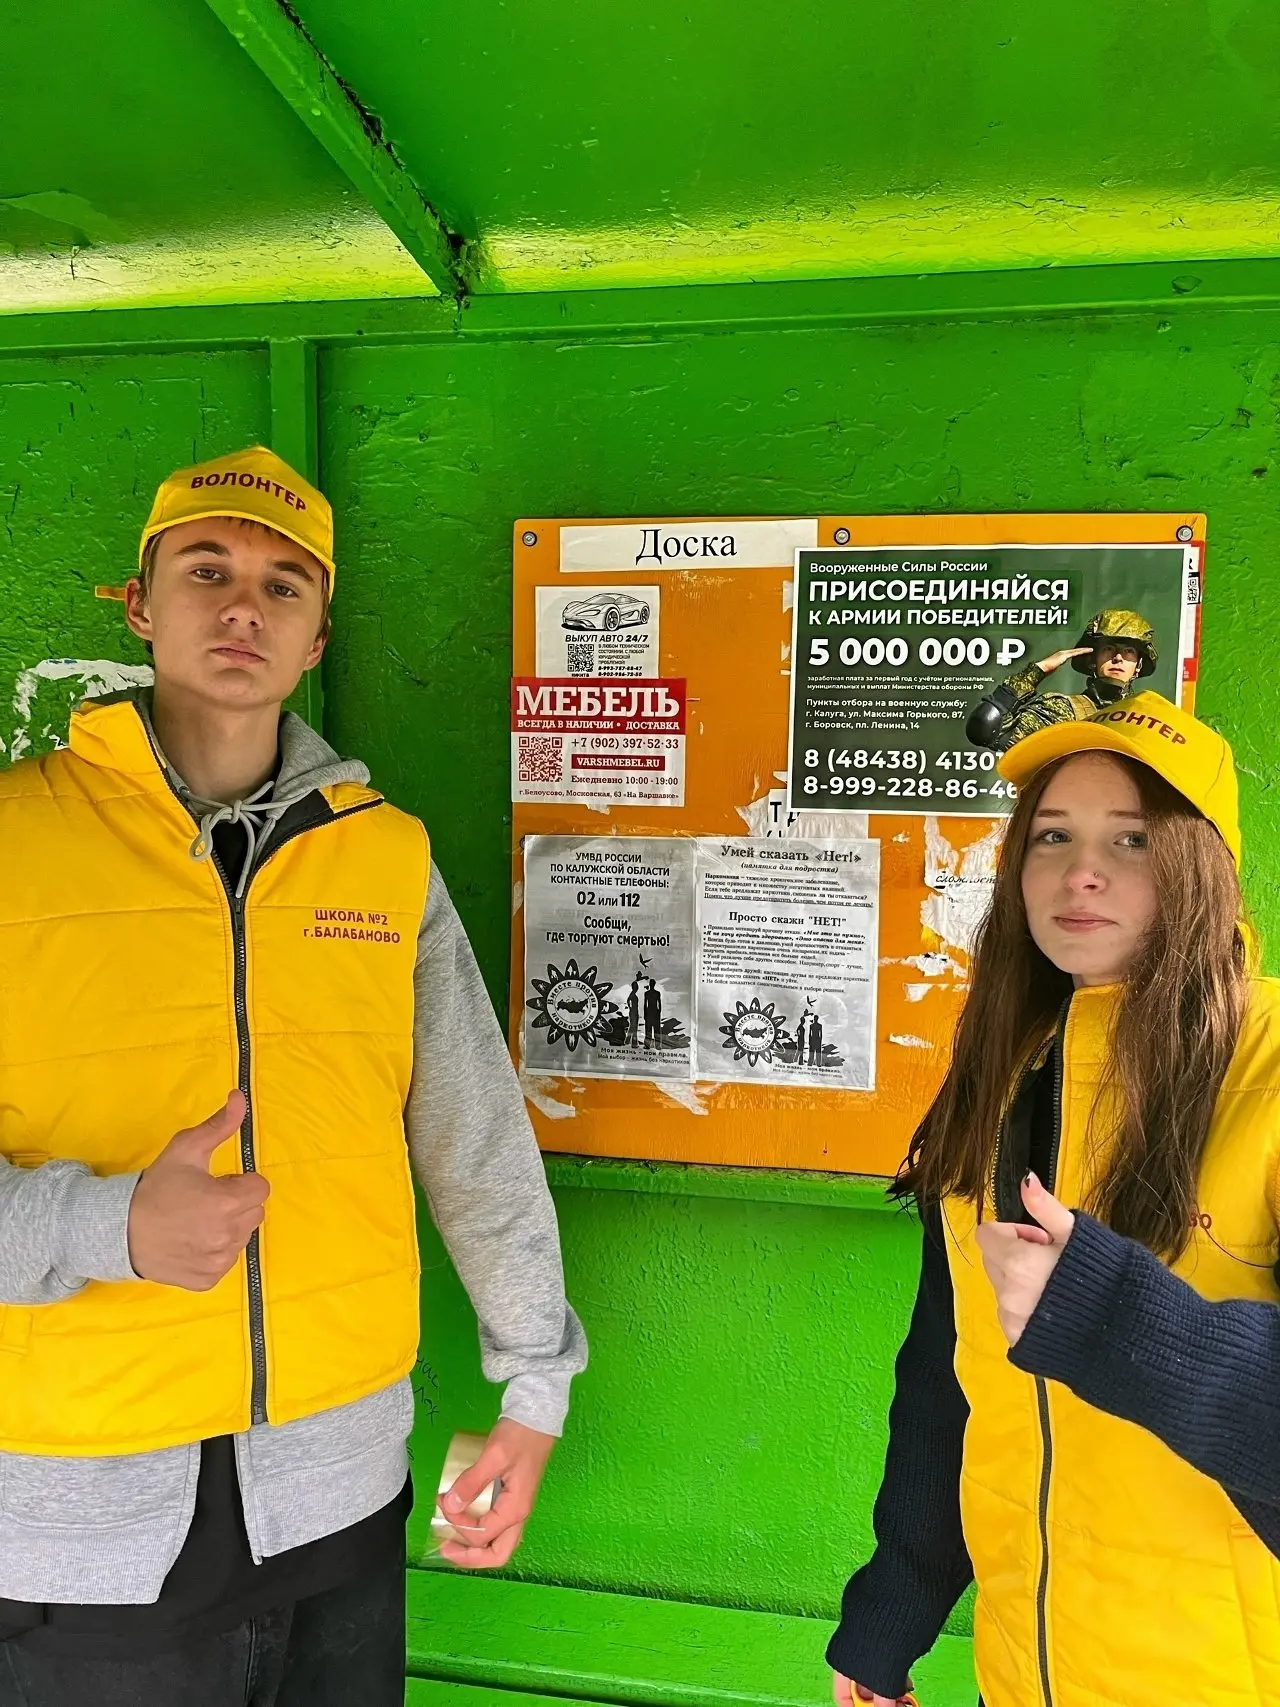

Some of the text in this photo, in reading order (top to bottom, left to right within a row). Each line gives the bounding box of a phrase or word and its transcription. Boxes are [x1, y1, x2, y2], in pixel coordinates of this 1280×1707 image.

[190, 472, 307, 511] ВОЛОНТЕР
[635, 528, 737, 566] Доска
[810, 561, 988, 575] Вооруженные Силы России
[809, 574, 1069, 604] ПРИСОЕДИНЯЙСЯ
[808, 606, 1068, 627] К АРМИИ ПОБЕДИТЕЛЕЙ!
[565, 634, 649, 643] ВЫКУП АВТО 24/7
[808, 638, 829, 666] 5
[839, 637, 908, 666] 000
[918, 637, 990, 666] 000
[516, 685, 680, 718] МЕБЕЛЬ
[806, 699, 840, 707] Пункты
[930, 700, 968, 708] службу:
[814, 710, 847, 718] Калуга,
[906, 711, 950, 720] Горького,
[951, 711, 965, 719] 87,
[517, 719, 556, 730] ВСЕГДА
[566, 720, 614, 729] НАЛИЧИИ
[626, 721, 680, 730] ДОСТАВКА
[814, 721, 854, 730] Боровск,
[870, 722, 908, 730] Ленина,
[571, 738, 587, 748] +7
[590, 737, 620, 750] (902)
[576, 757, 660, 768] VARSHMEBEL.RU
[804, 749, 819, 768] 8
[827, 748, 927, 774] (48438)
[571, 775, 678, 786] Ежедневно 10:00 19:00
[803, 775, 1018, 799] 8-999-228-86-46
[519, 789, 564, 798] г.Белоусово,
[566, 790, 612, 798] Московская,
[575, 852, 642, 863] УМВД РОССИИ
[720, 844, 862, 863] Умей сказать «Нет!»
[550, 863, 670, 876] ПО КАЛУЖСКОЙ ОБЛАСТИ
[741, 862, 777, 870] (памятка
[794, 865, 839, 874] подростка)
[550, 876, 670, 888] КОНТАКТНЫЕ ТЕЛЕФОНЫ:
[576, 891, 641, 908] 02 или 112
[315, 909, 388, 926] ШКОЛА №2
[584, 916, 632, 932] Сообщи,
[729, 912, 846, 927] Просто скажи "НЕТ!"
[303, 926, 400, 944] г.БАЛАБАНОВО
[546, 931, 670, 948] где торгуют смертью!
[547, 981, 598, 1031] Вместе против наркотиков
